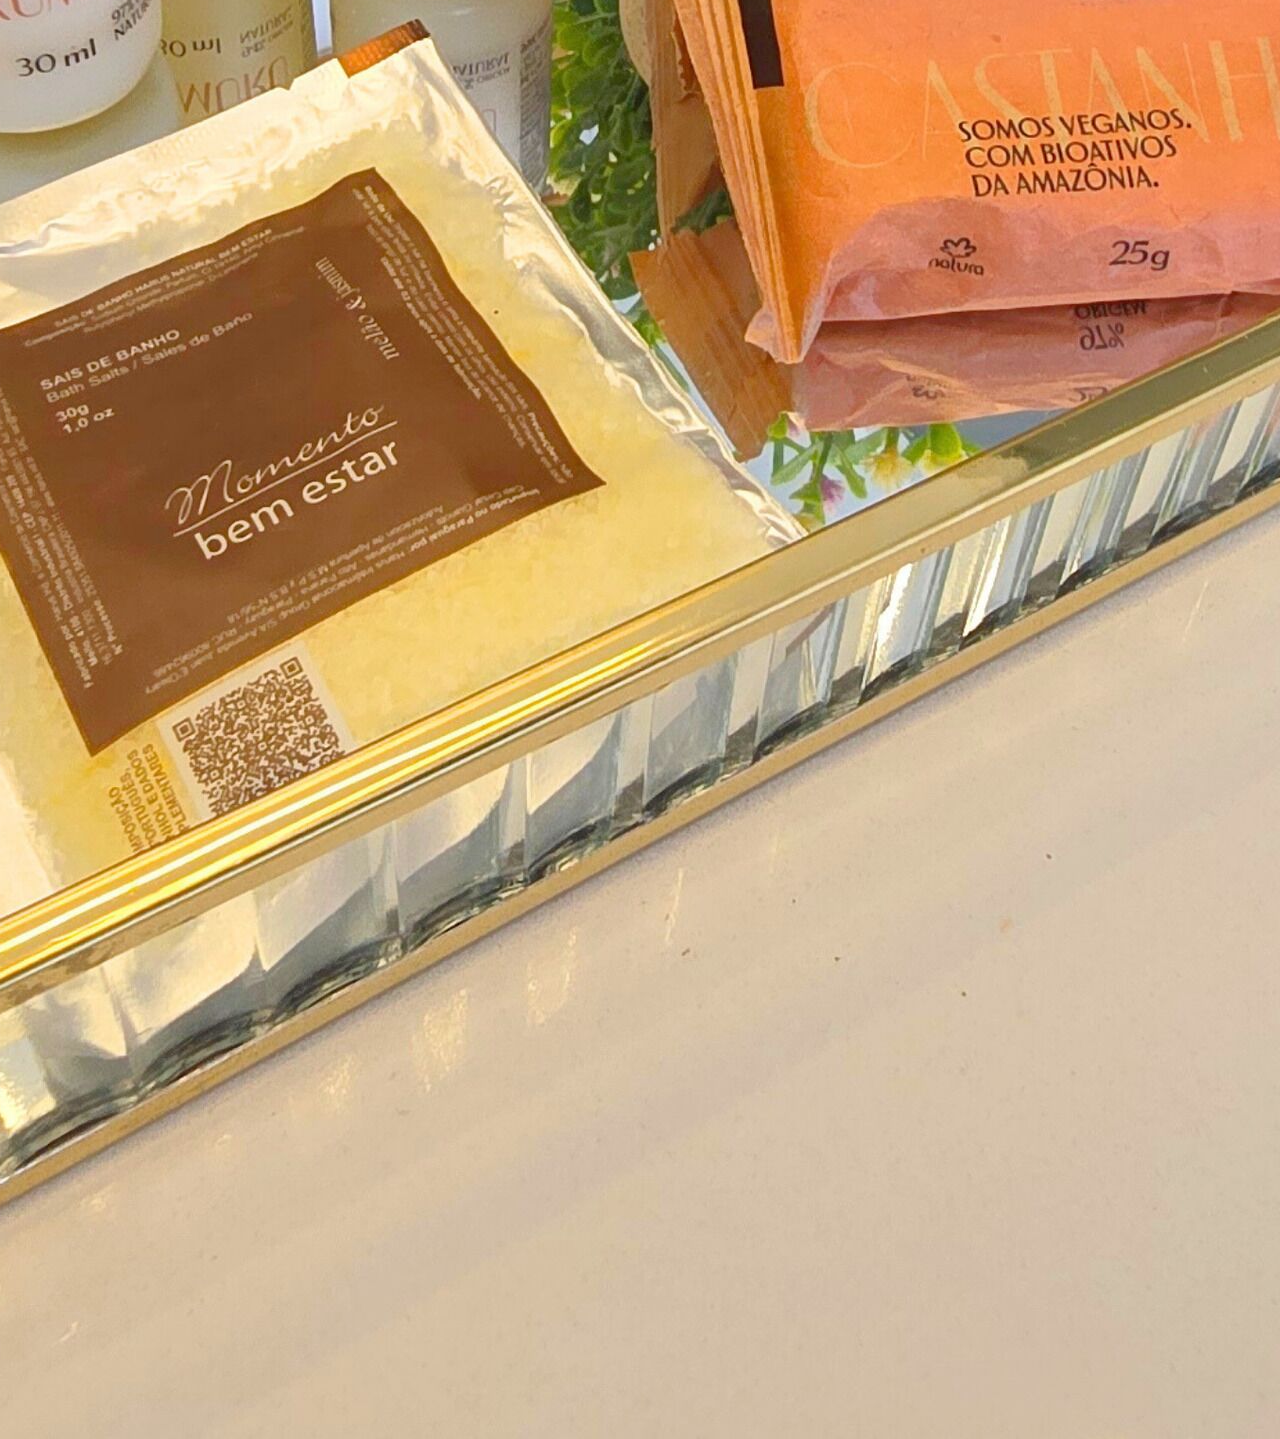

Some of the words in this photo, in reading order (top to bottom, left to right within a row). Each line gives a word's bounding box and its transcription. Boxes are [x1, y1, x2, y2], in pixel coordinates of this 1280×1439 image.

[14, 53, 57, 77] 30
[64, 37, 98, 67] ml
[958, 116, 1056, 143] SOMOS
[1059, 107, 1193, 138] VEGANOS.
[965, 141, 1037, 169] COM
[1041, 134, 1178, 166] BIOATIVOS
[972, 171, 1009, 199] DA
[1015, 162, 1160, 195] AMAZÔNIA.
[928, 257, 985, 276] natura
[1109, 240, 1170, 271] 25g
[315, 256, 361, 301] jasmim
[345, 295, 367, 310] &
[40, 367, 84, 391] SAIS
[86, 356, 112, 373] DE
[116, 329, 180, 362] BANHO
[46, 382, 85, 404] Bath
[88, 365, 130, 387] Salts
[141, 343, 187, 365] Sales
[189, 333, 210, 348] de
[212, 312, 253, 337] Baño
[56, 404, 90, 423] 30g
[93, 408, 115, 422] oz
[164, 404, 385, 525] Momento
[194, 498, 294, 560] bem
[302, 441, 398, 504] estar
[126, 749, 153, 795] DADOS
[142, 744, 189, 832] PLEMENTARES
